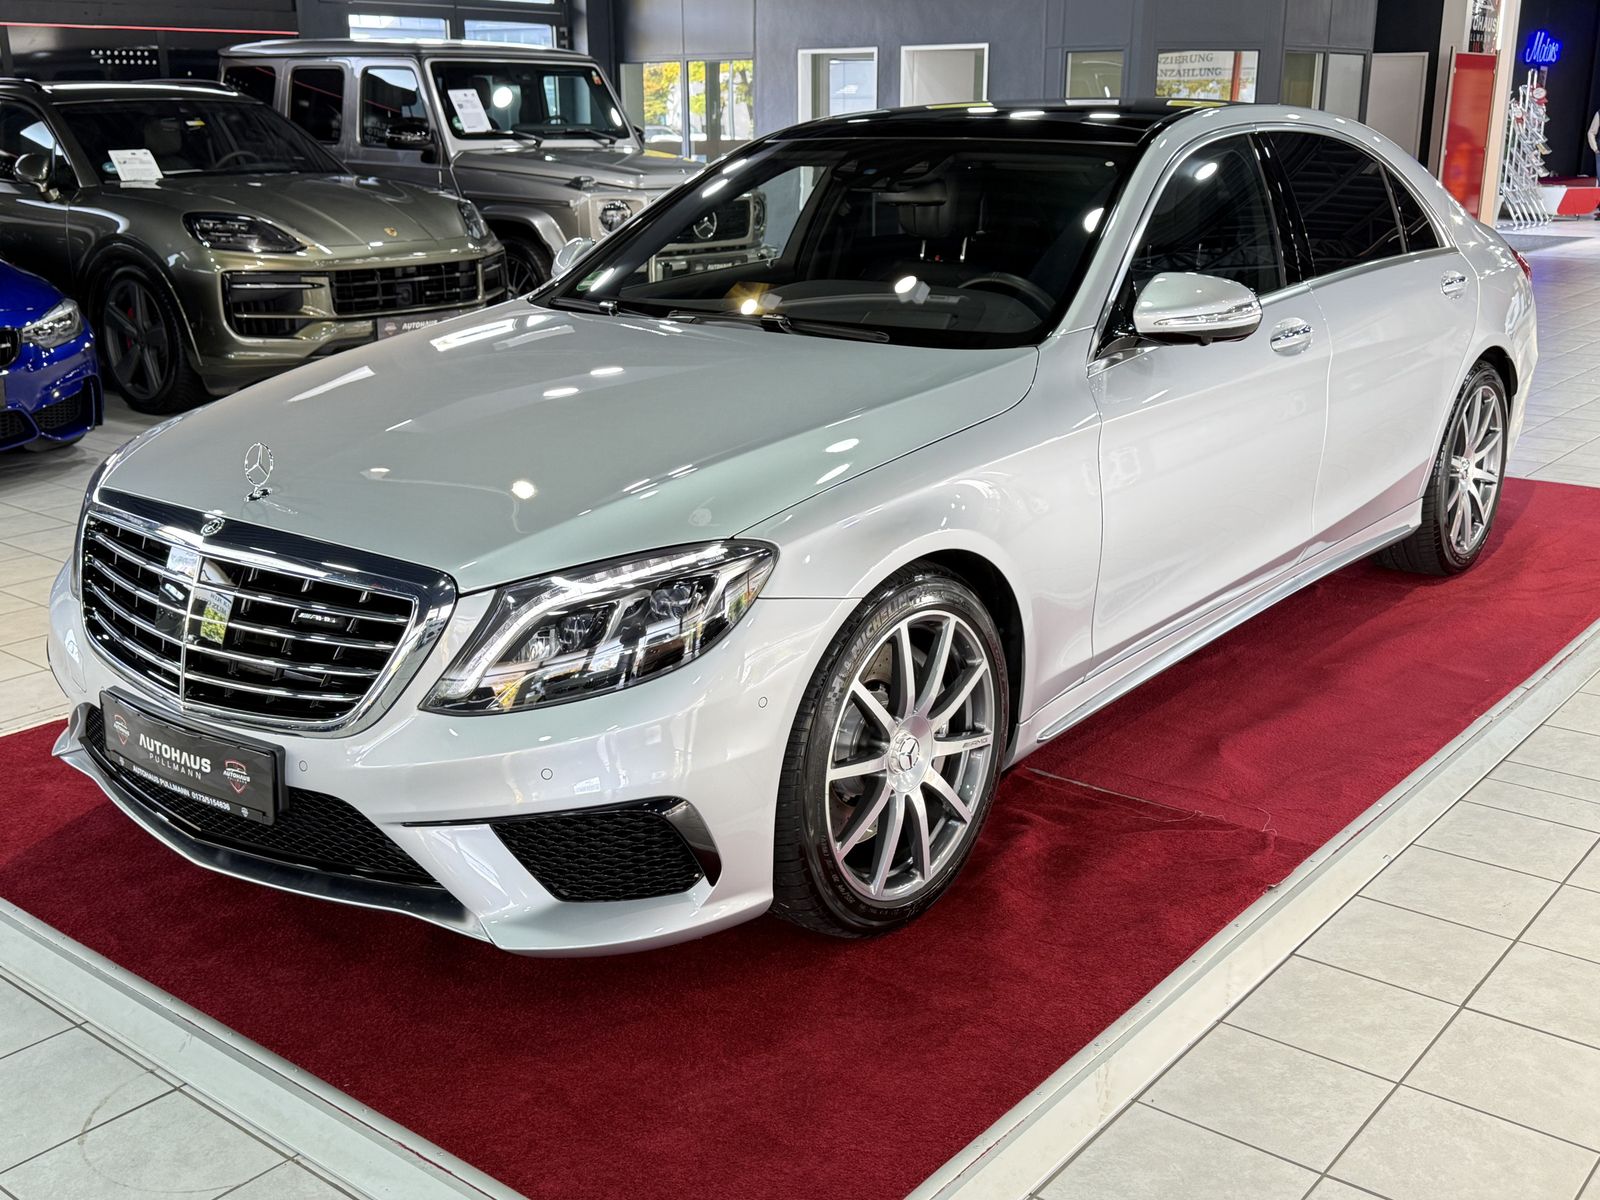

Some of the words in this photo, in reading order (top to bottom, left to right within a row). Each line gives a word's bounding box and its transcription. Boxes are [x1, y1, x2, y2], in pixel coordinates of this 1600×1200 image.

[851, 588, 913, 660] MICHELIN
[139, 733, 211, 773] AUTOHAUS
[149, 752, 202, 781] PULLMANN
